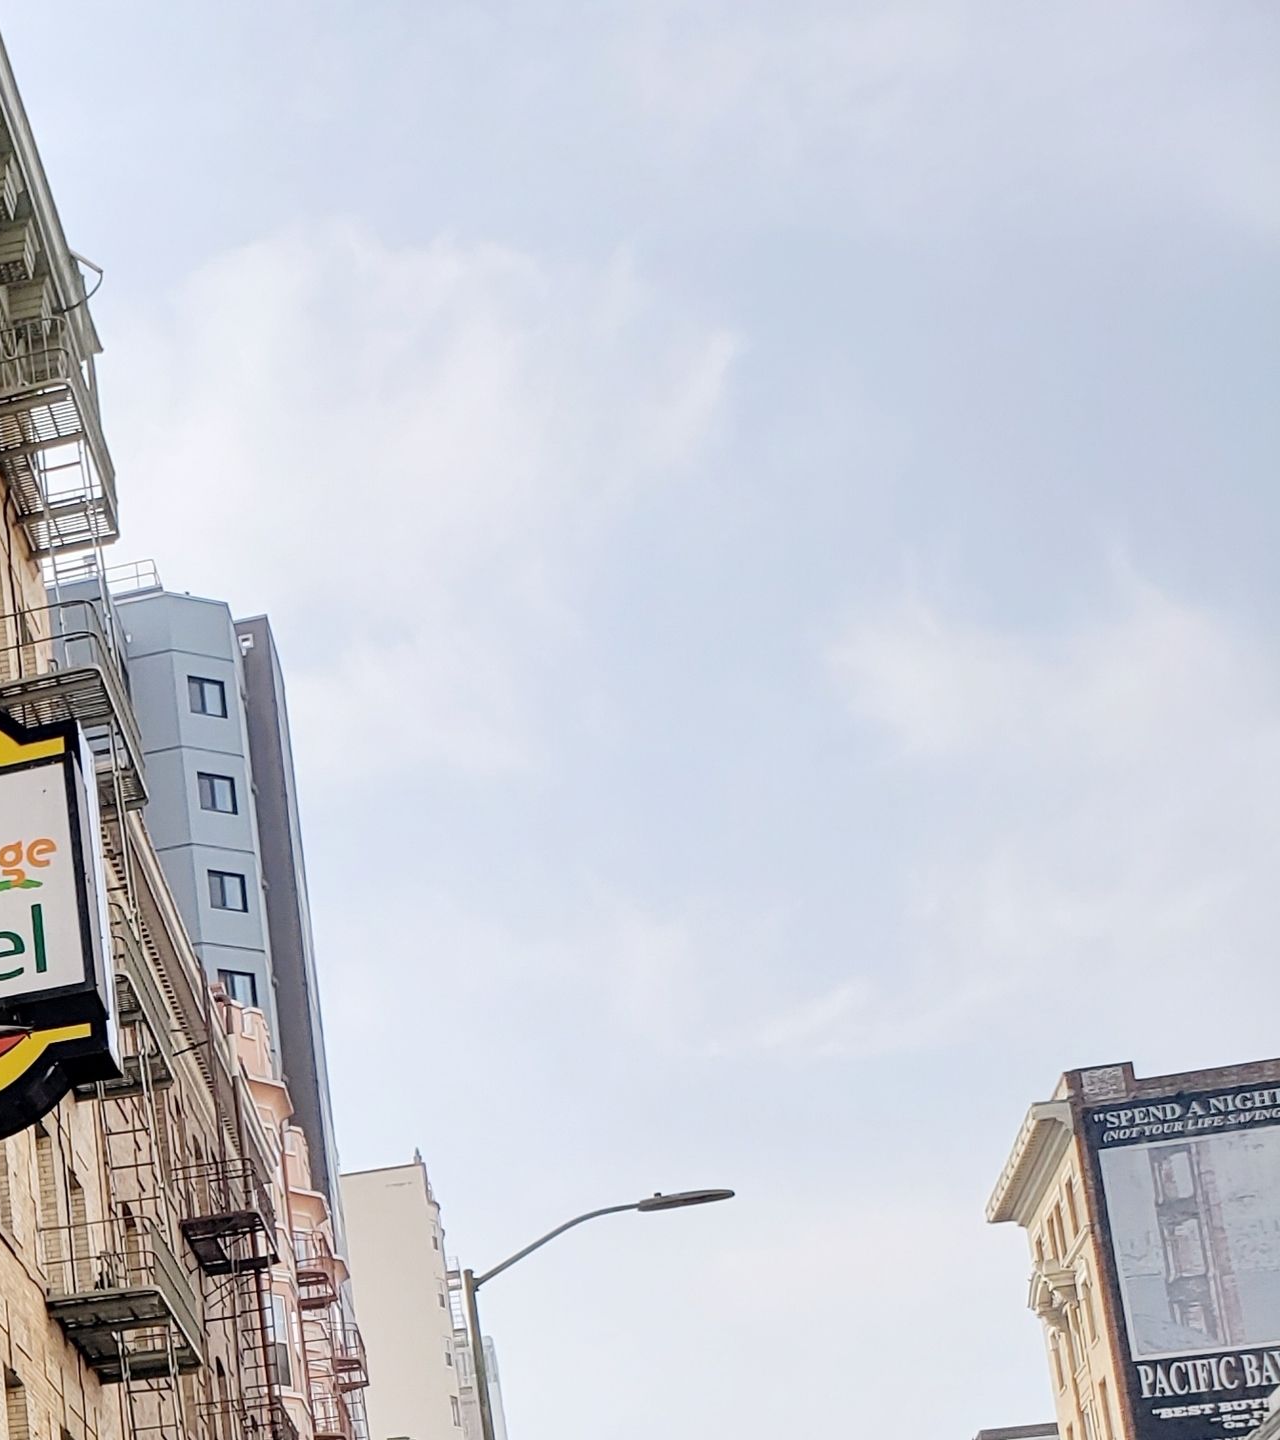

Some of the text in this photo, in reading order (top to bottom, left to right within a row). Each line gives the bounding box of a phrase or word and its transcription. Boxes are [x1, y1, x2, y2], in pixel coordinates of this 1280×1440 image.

[1187, 1101, 1205, 1117] A
[1103, 1126, 1143, 1143] (NOT
[1142, 1122, 1184, 1137] YOUR
[1187, 1115, 1224, 1130] LIFE
[1137, 1355, 1239, 1399] PACIFIC
